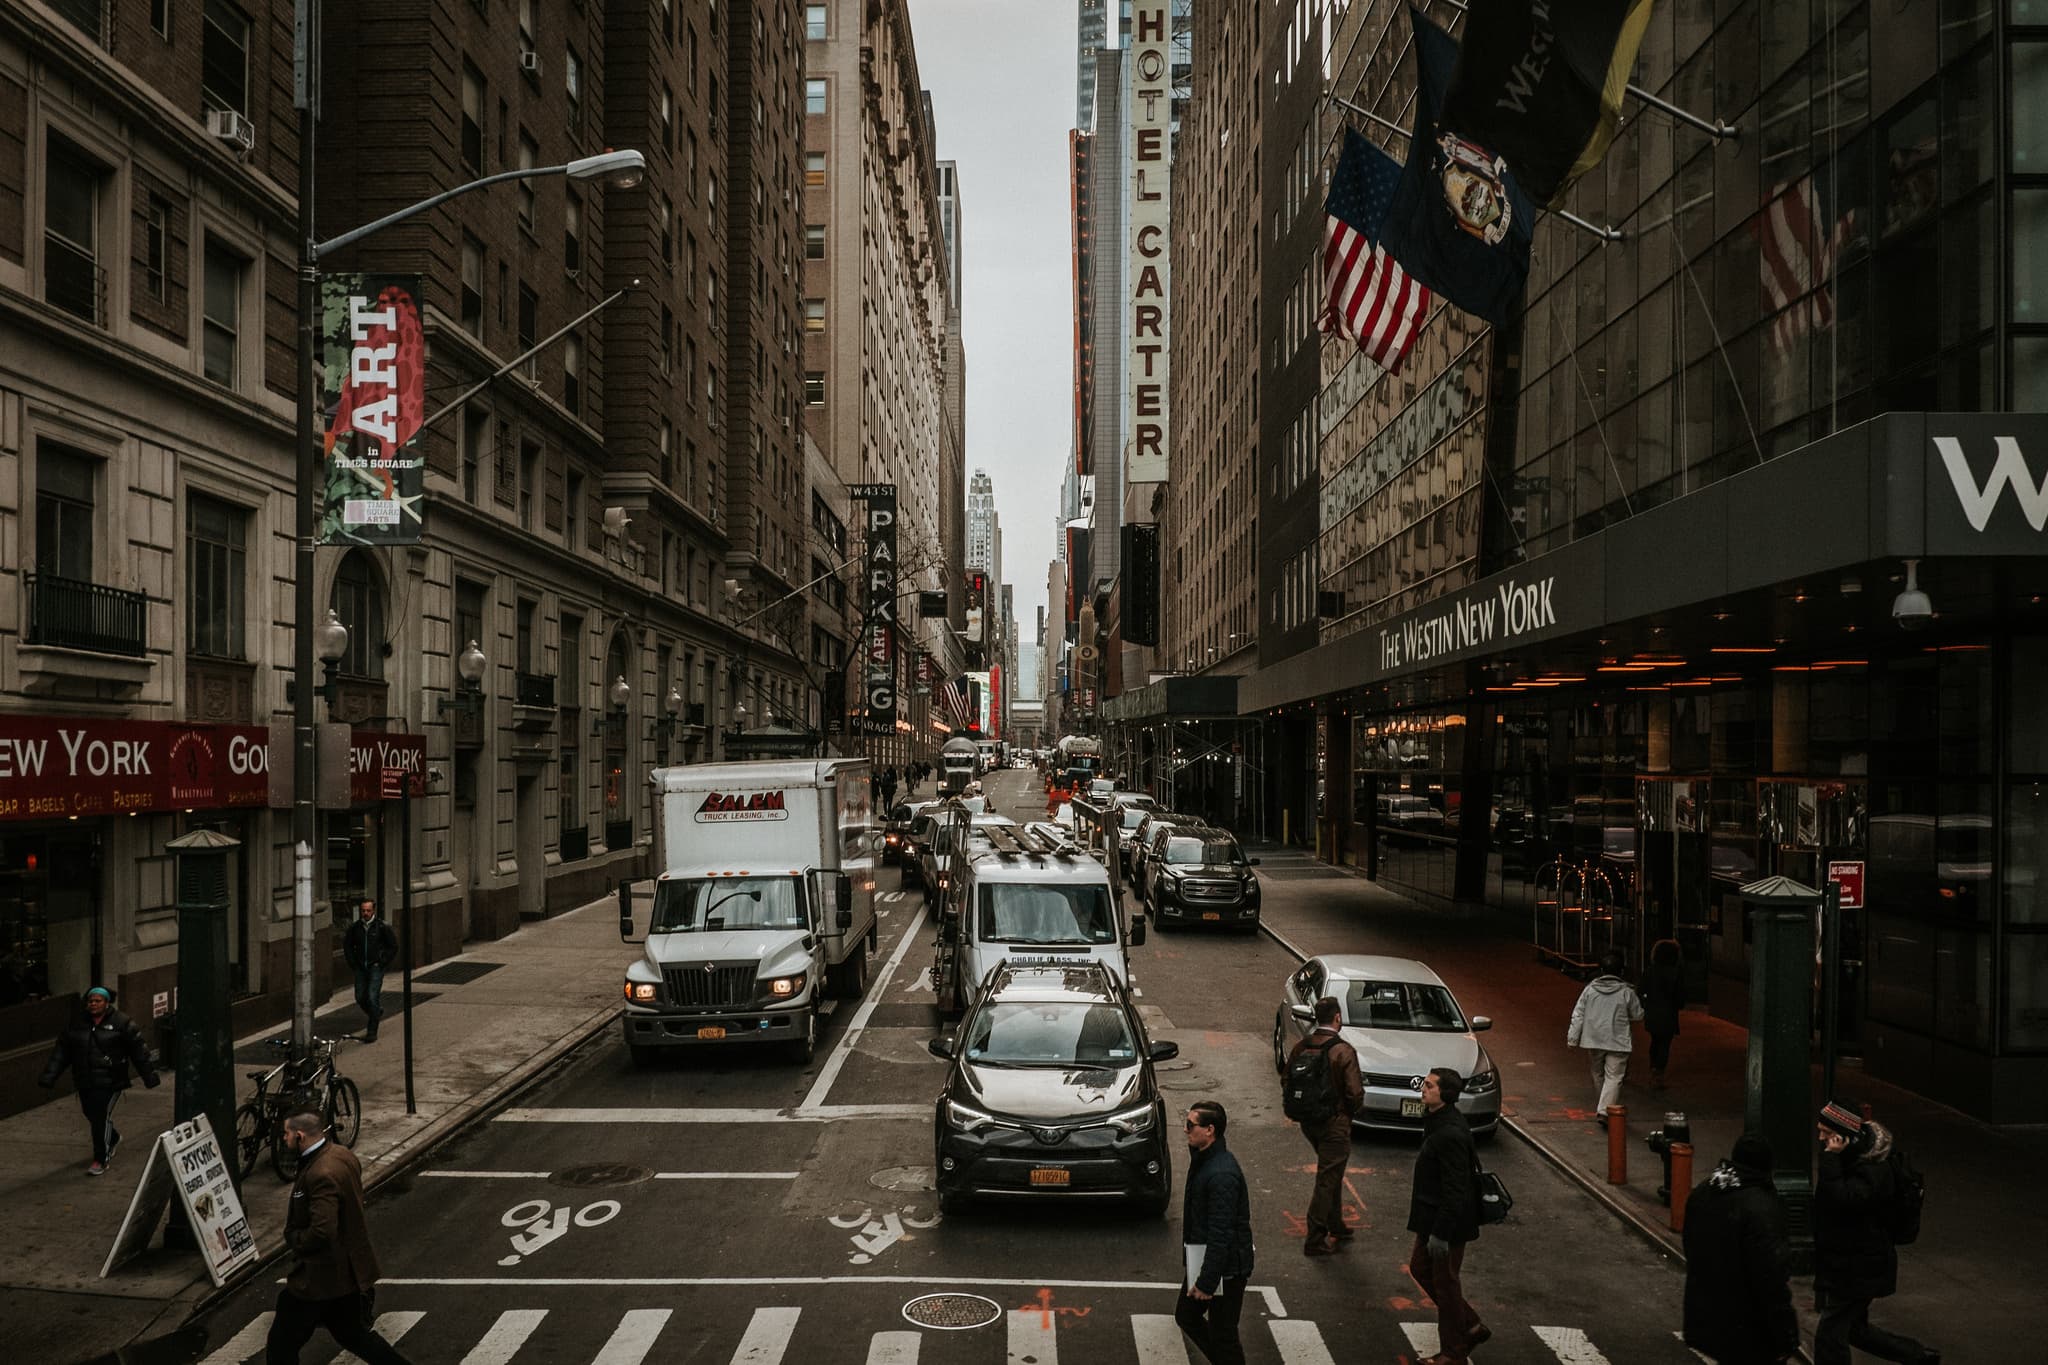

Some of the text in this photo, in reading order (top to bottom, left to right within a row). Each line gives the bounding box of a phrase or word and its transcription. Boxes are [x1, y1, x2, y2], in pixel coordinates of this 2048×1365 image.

[1135, 9, 1164, 456] HOTEL CARTER
[349, 295, 397, 444] ART
[334, 458, 413, 469] TIMES SQUARE
[367, 446, 378, 457] in
[853, 486, 894, 496] W 43 ST
[366, 501, 394, 509] TIMES
[366, 508, 399, 516] SQUARE
[366, 515, 390, 523] ARTS
[1379, 576, 1556, 670] THE WESTIN NEW YORK
[873, 625, 886, 662] ART
[918, 655, 928, 680] ART
[57, 729, 152, 776] YORK
[377, 741, 419, 774] YORK
[29, 796, 65, 813] BAGELS
[113, 789, 152, 809] PASTRIES
[702, 790, 785, 812] SALEM
[704, 812, 728, 820] TRUCK
[182, 1141, 216, 1174] PSYCHIC
